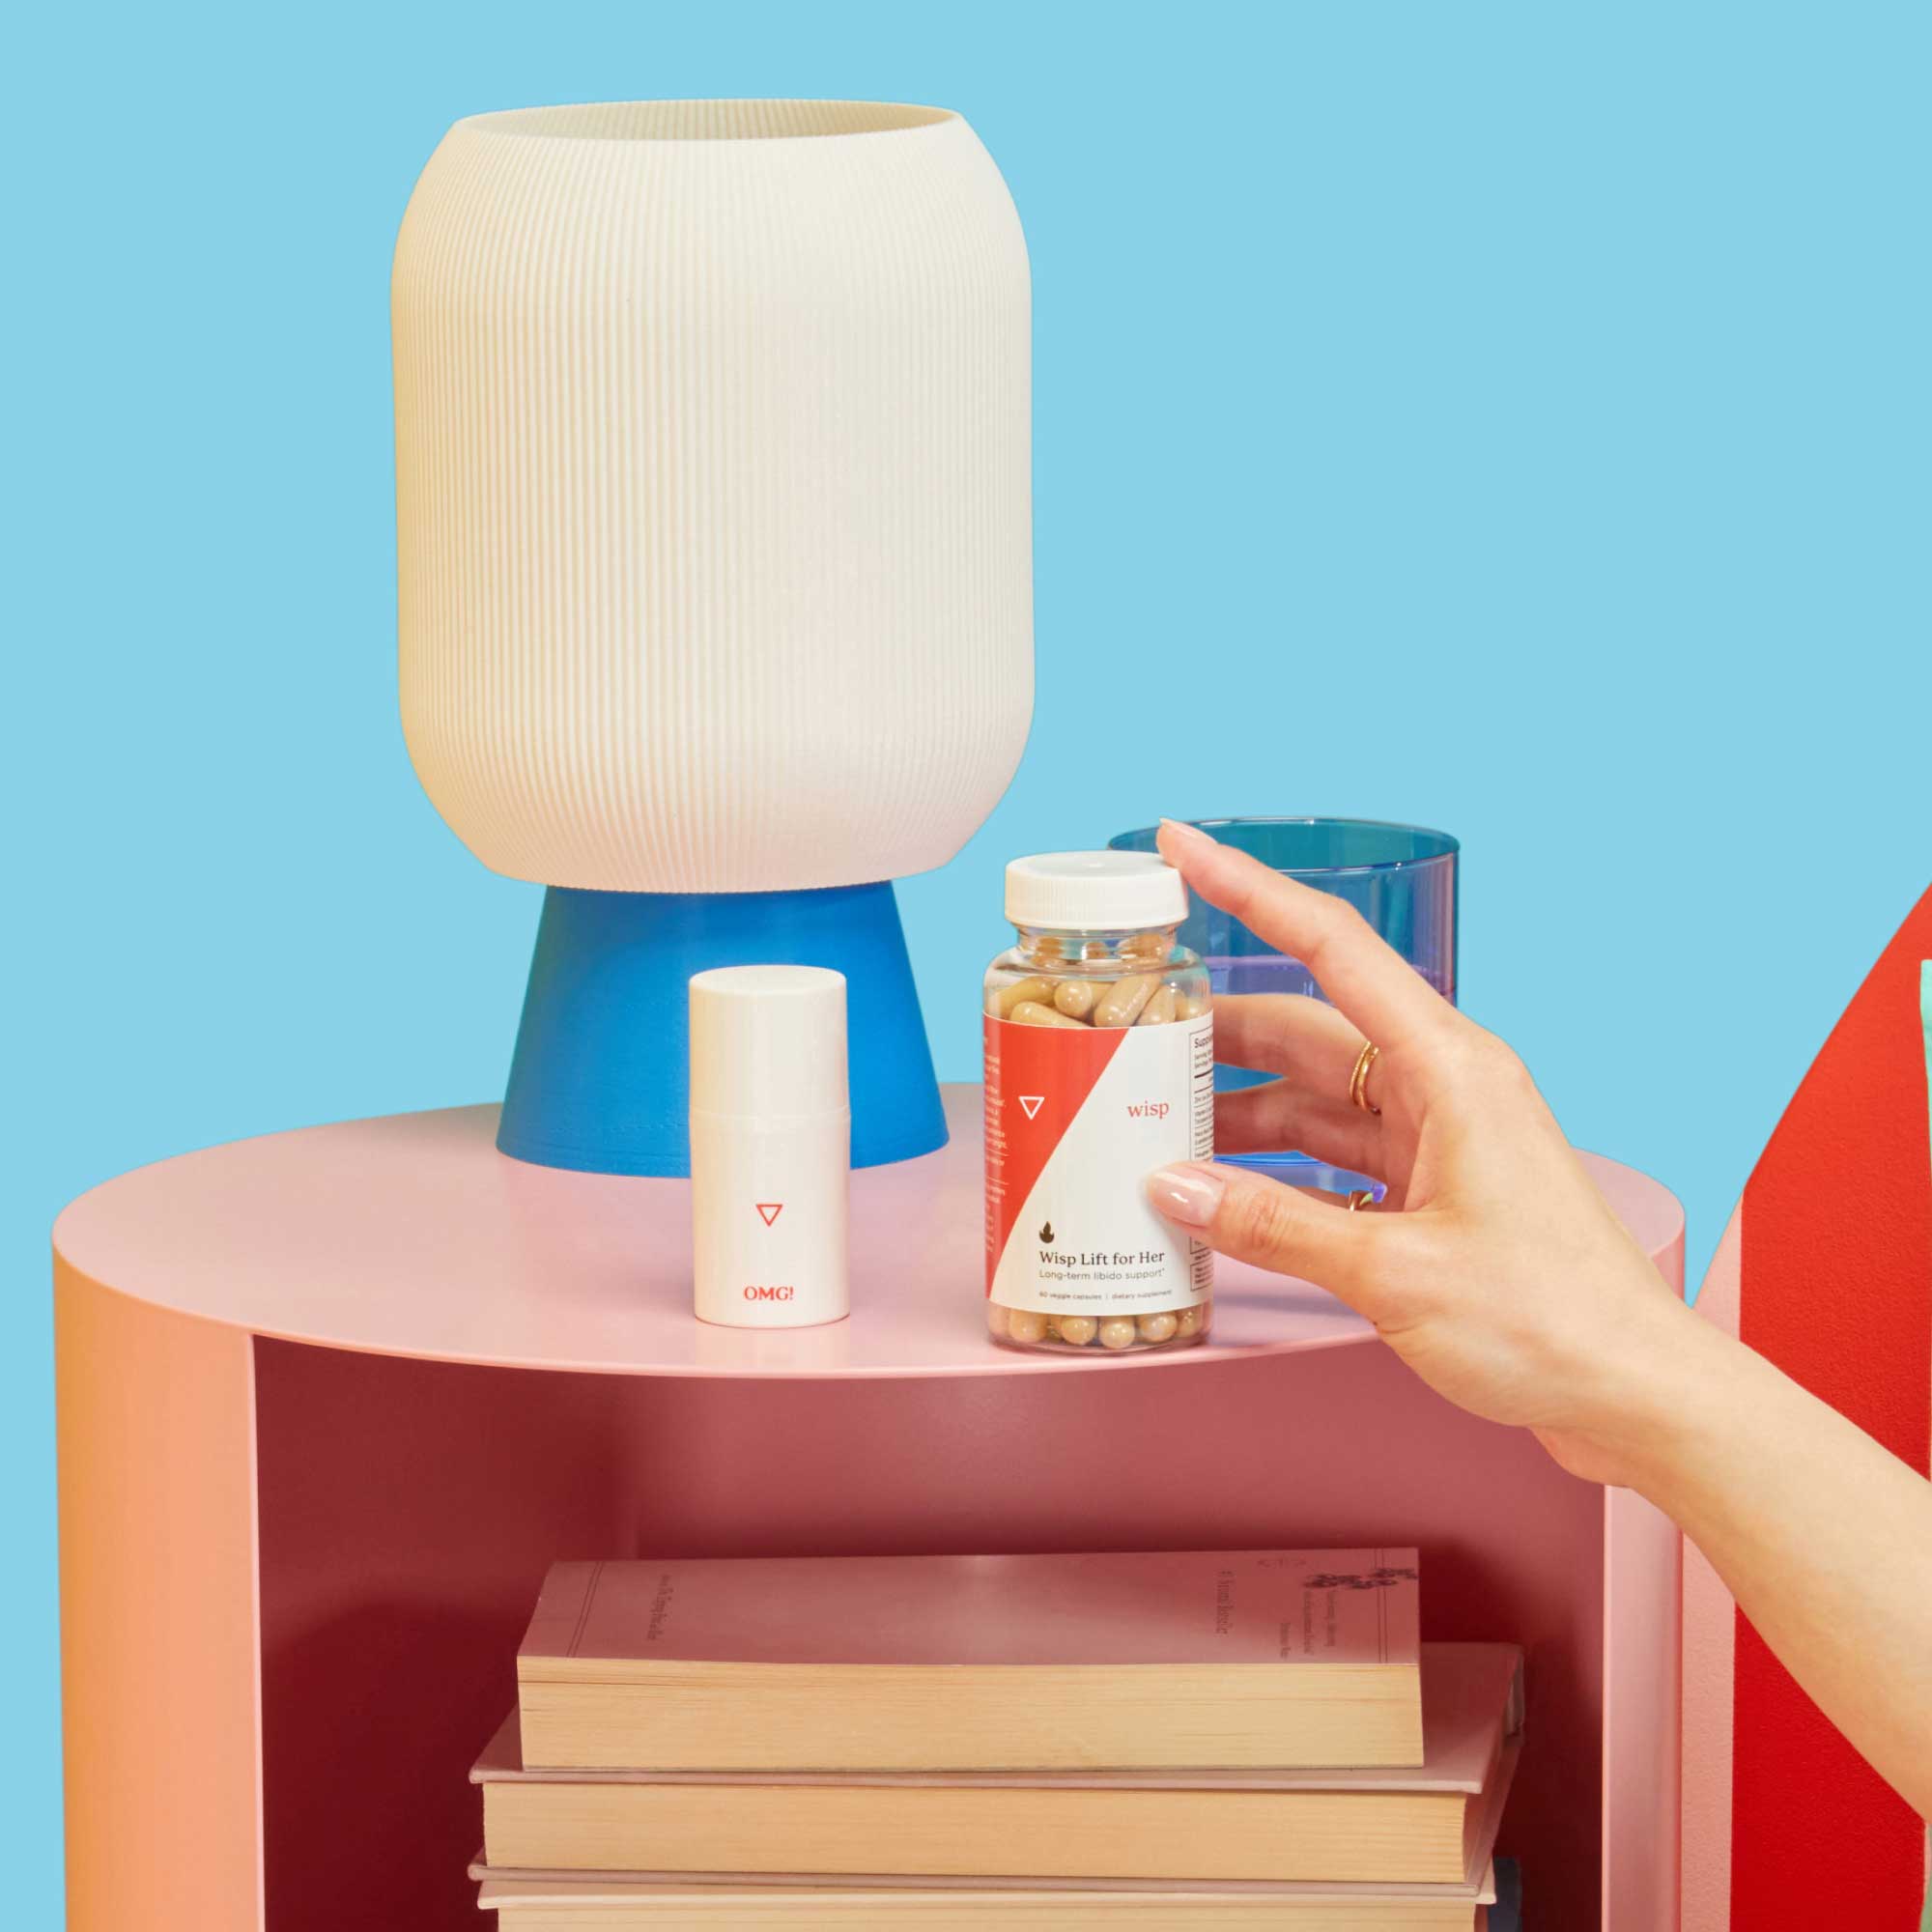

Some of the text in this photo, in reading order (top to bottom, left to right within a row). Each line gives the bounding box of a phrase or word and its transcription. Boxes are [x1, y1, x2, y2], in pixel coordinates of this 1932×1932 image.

[1127, 1100, 1170, 1119] wisp
[1039, 1251, 1165, 1267] Wisp Lift for Her
[1038, 1269, 1091, 1281] Long-term
[1094, 1269, 1122, 1280] libido
[743, 1286, 794, 1301] OMG!
[1049, 1292, 1071, 1300] veggie
[1111, 1292, 1135, 1300] dietary
[1137, 1289, 1173, 1298] supplement
